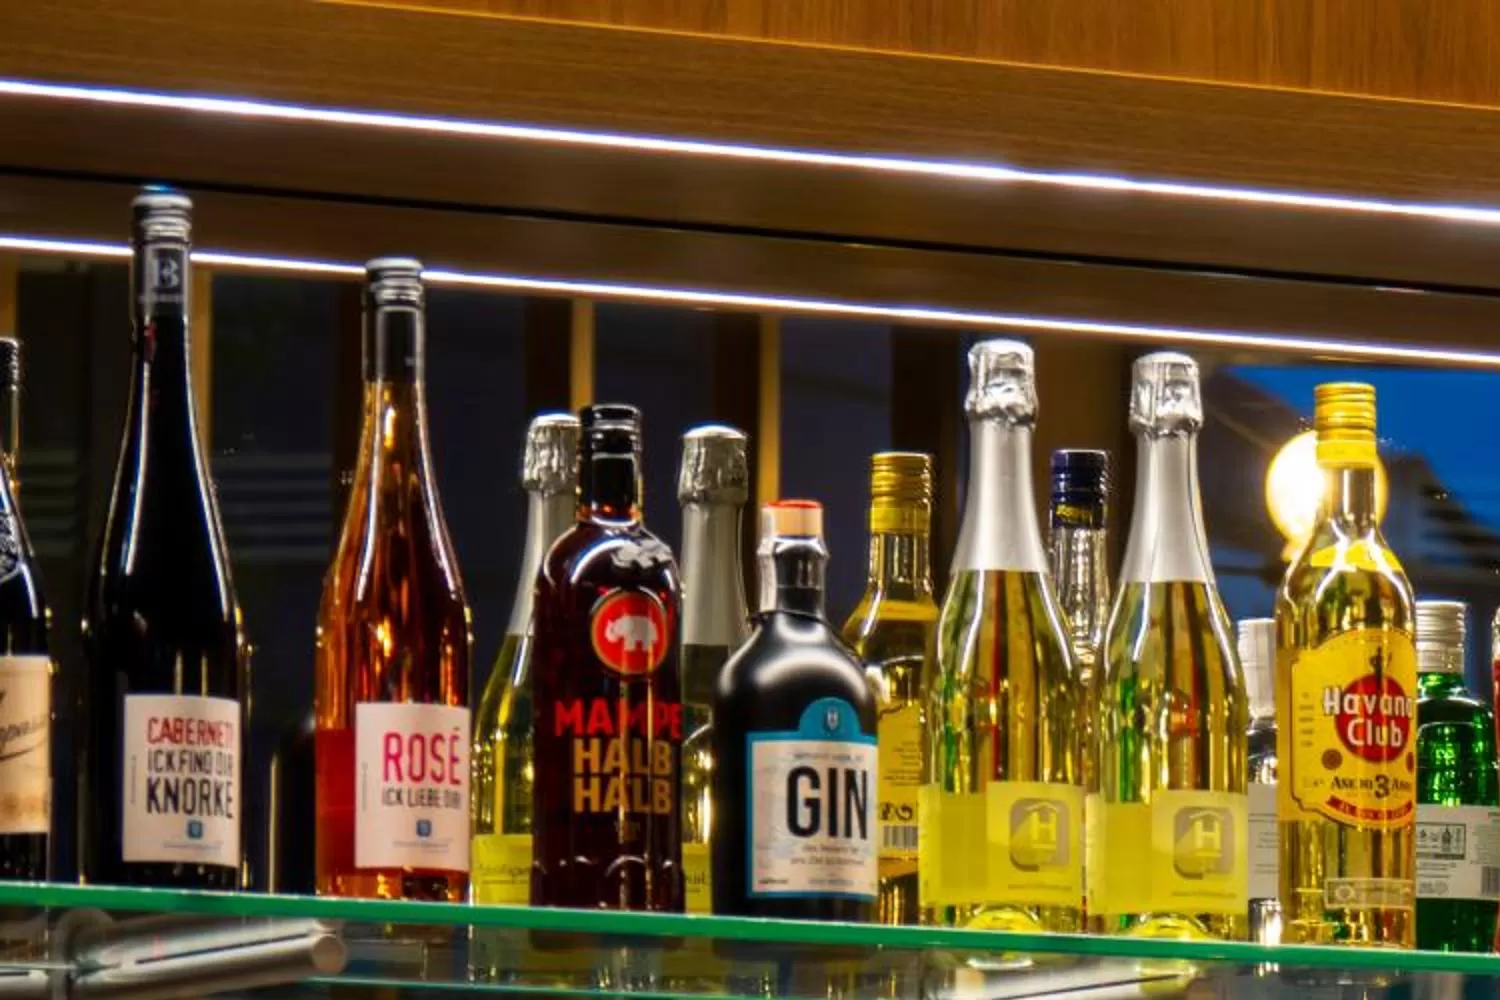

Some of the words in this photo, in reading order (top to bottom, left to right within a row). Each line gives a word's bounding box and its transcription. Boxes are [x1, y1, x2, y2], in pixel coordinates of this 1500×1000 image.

[554, 698, 682, 738] MAMPE
[1347, 717, 1402, 747] Club
[574, 737, 672, 774] HALB
[146, 778, 233, 819] KNORKE
[574, 777, 672, 814] HALB
[786, 766, 867, 838] GIN
[1375, 774, 1390, 799] 3
